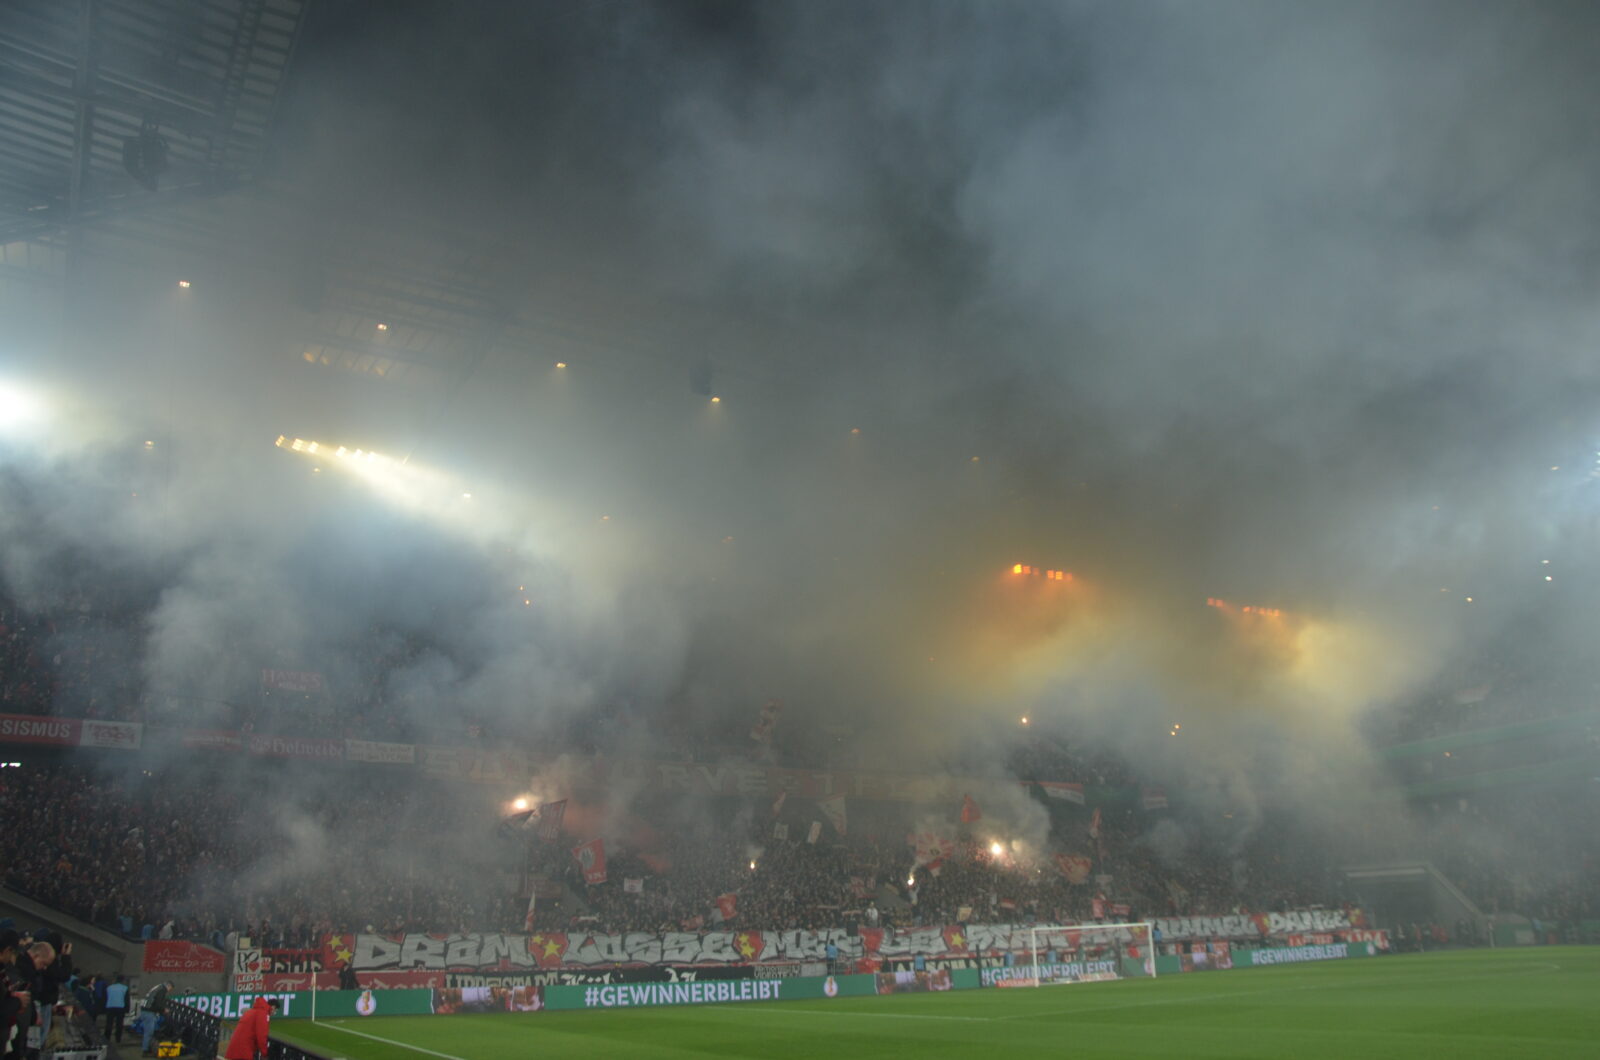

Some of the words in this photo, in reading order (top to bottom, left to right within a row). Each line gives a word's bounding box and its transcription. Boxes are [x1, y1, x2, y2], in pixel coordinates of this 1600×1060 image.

[2, 719, 71, 738] SISMUS
[1252, 943, 1348, 966] #GEWINNERBLEIBT
[585, 979, 782, 1007] #GEWINNERBLEIBT
